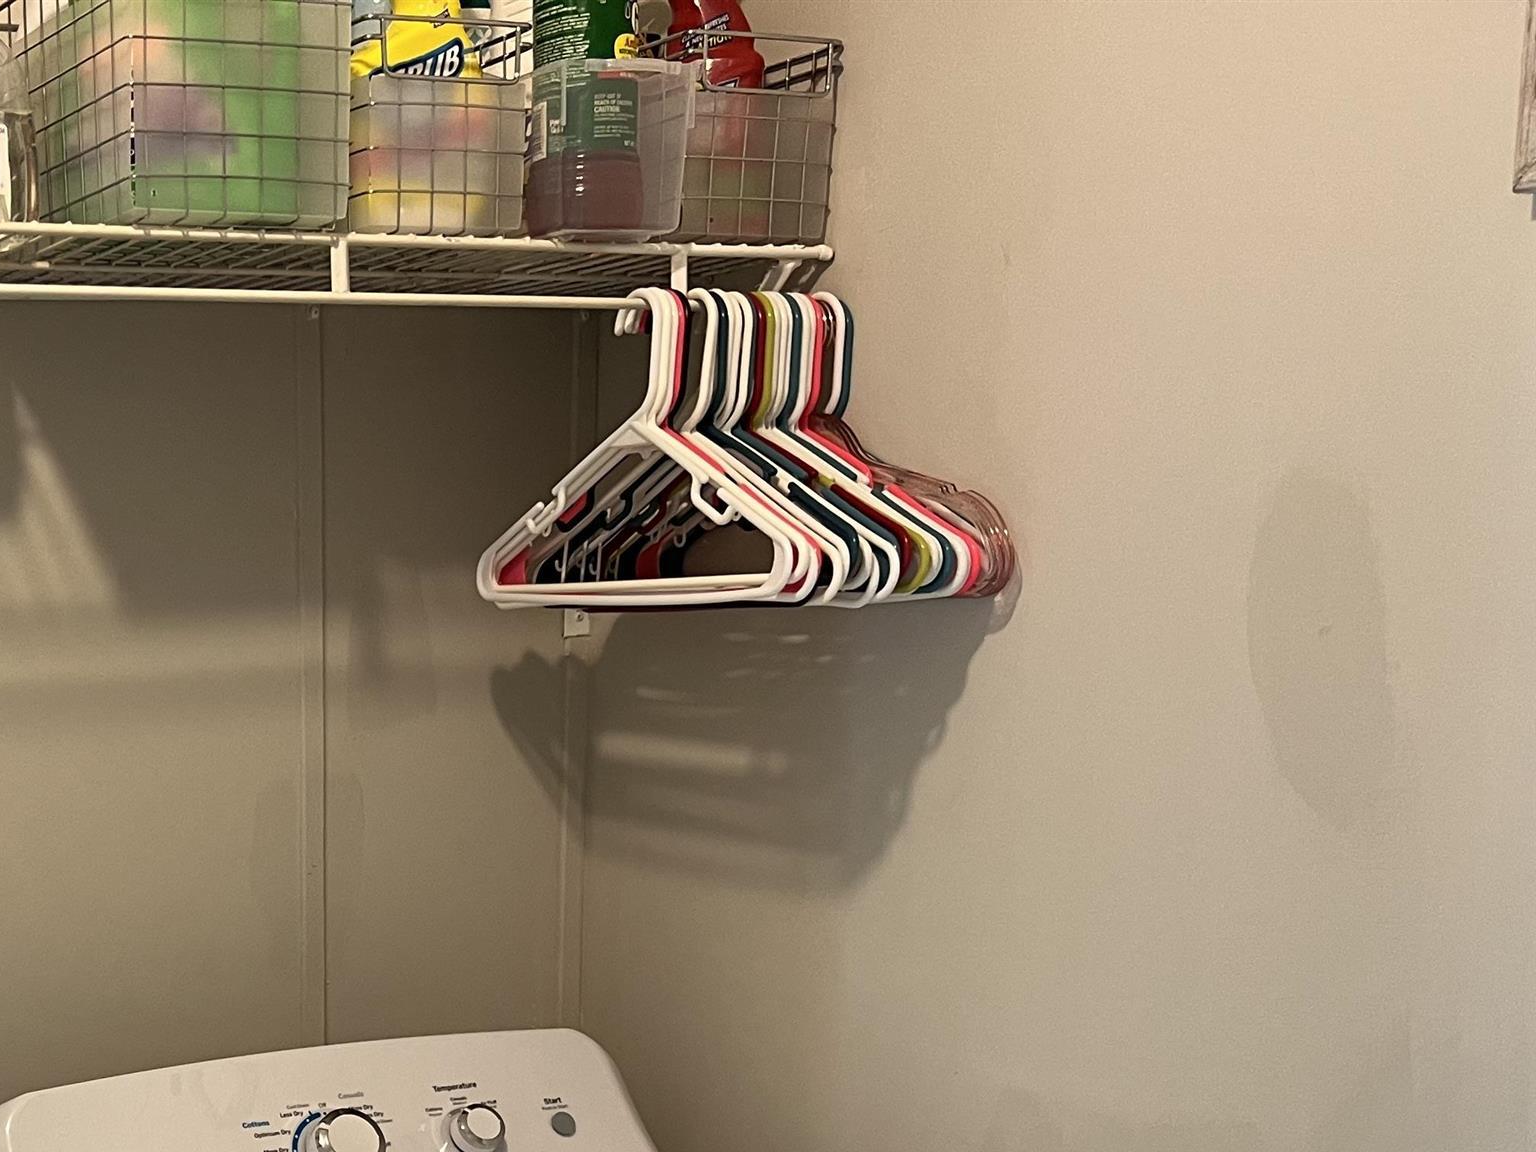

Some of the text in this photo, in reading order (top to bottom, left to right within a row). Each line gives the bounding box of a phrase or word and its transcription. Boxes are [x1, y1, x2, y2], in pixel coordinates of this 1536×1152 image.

[698, 35, 732, 49] ATION
[432, 1082, 477, 1093] Temperature
[543, 1097, 562, 1105] Start
[364, 1104, 374, 1112] Dry
[242, 1120, 270, 1129] Cottons
[254, 1131, 280, 1139] Optimum
